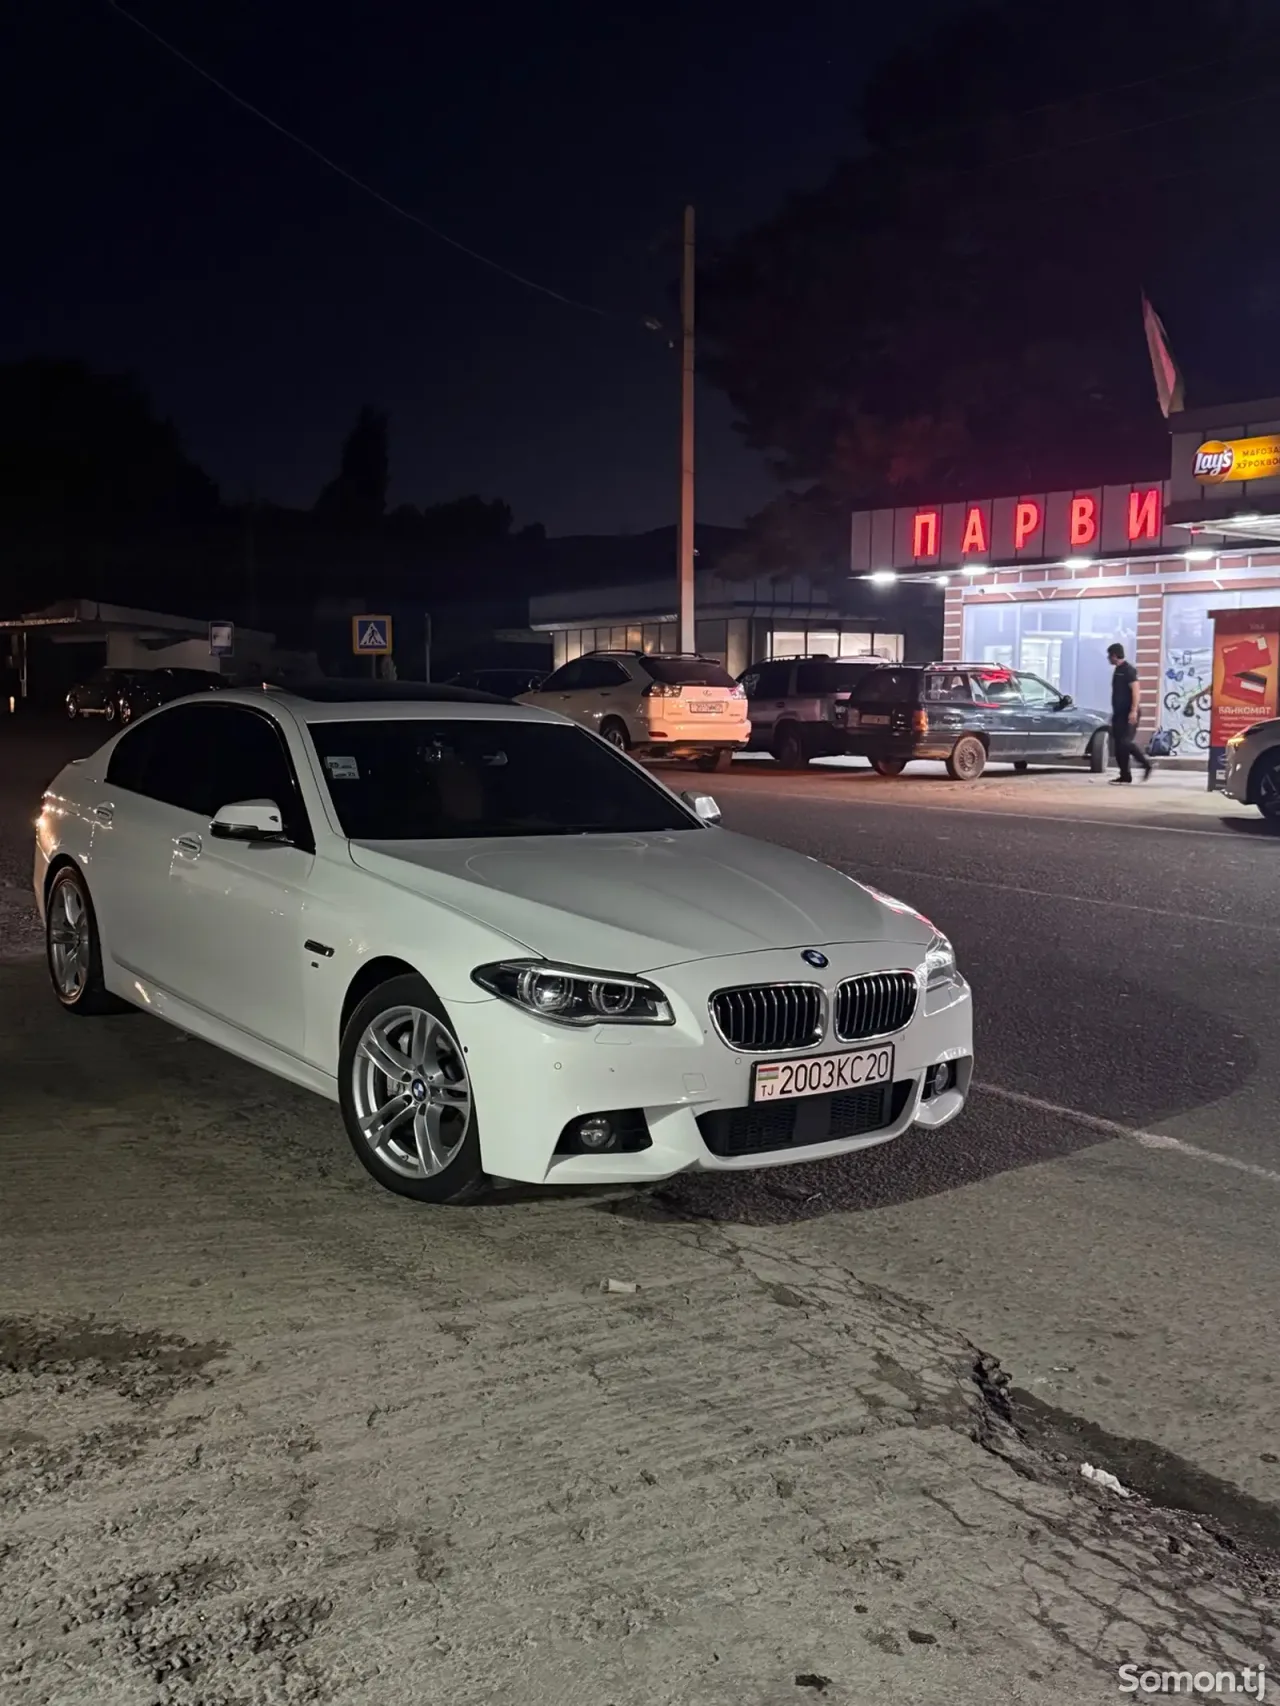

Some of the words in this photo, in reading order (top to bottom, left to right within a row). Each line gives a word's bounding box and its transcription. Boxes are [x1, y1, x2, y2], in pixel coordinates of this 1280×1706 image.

[1194, 449, 1232, 476] Lay's
[913, 490, 1200, 557] ПАРВИ
[1218, 706, 1272, 716] БАНКОМАТ
[780, 1051, 889, 1095] 2003KC20
[761, 1084, 774, 1097] TJ
